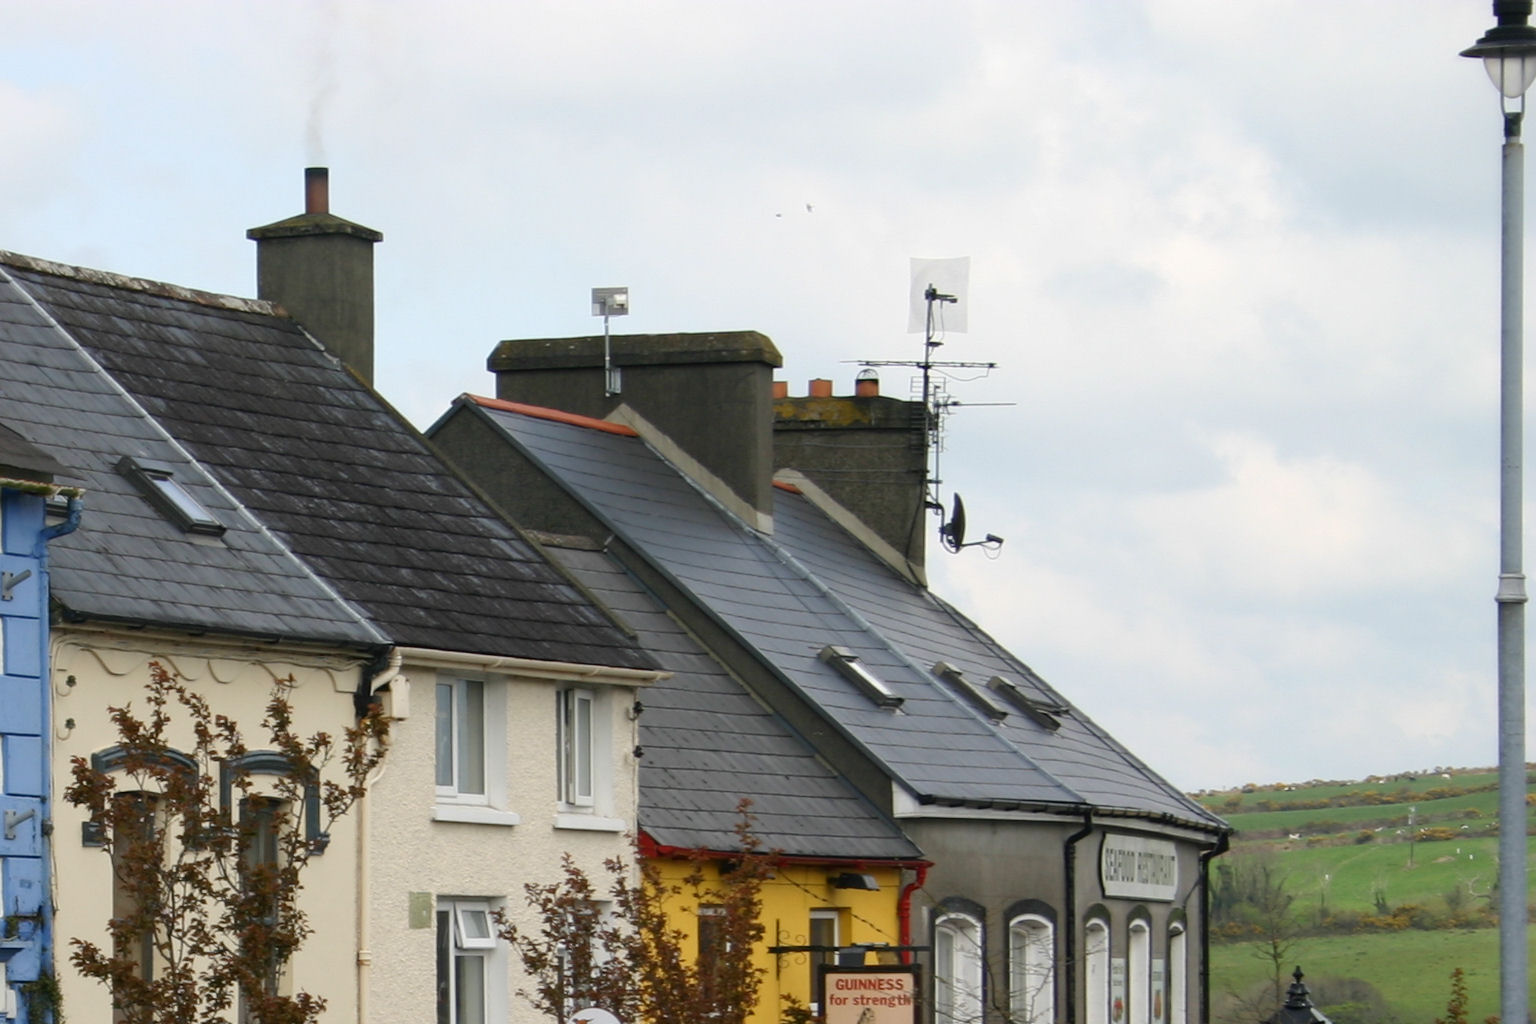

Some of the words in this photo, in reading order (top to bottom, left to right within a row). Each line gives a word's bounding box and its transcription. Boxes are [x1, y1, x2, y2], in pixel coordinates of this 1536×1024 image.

[835, 978, 904, 991] GUINNESS
[829, 994, 849, 1006] for
[853, 994, 912, 1008] strength
